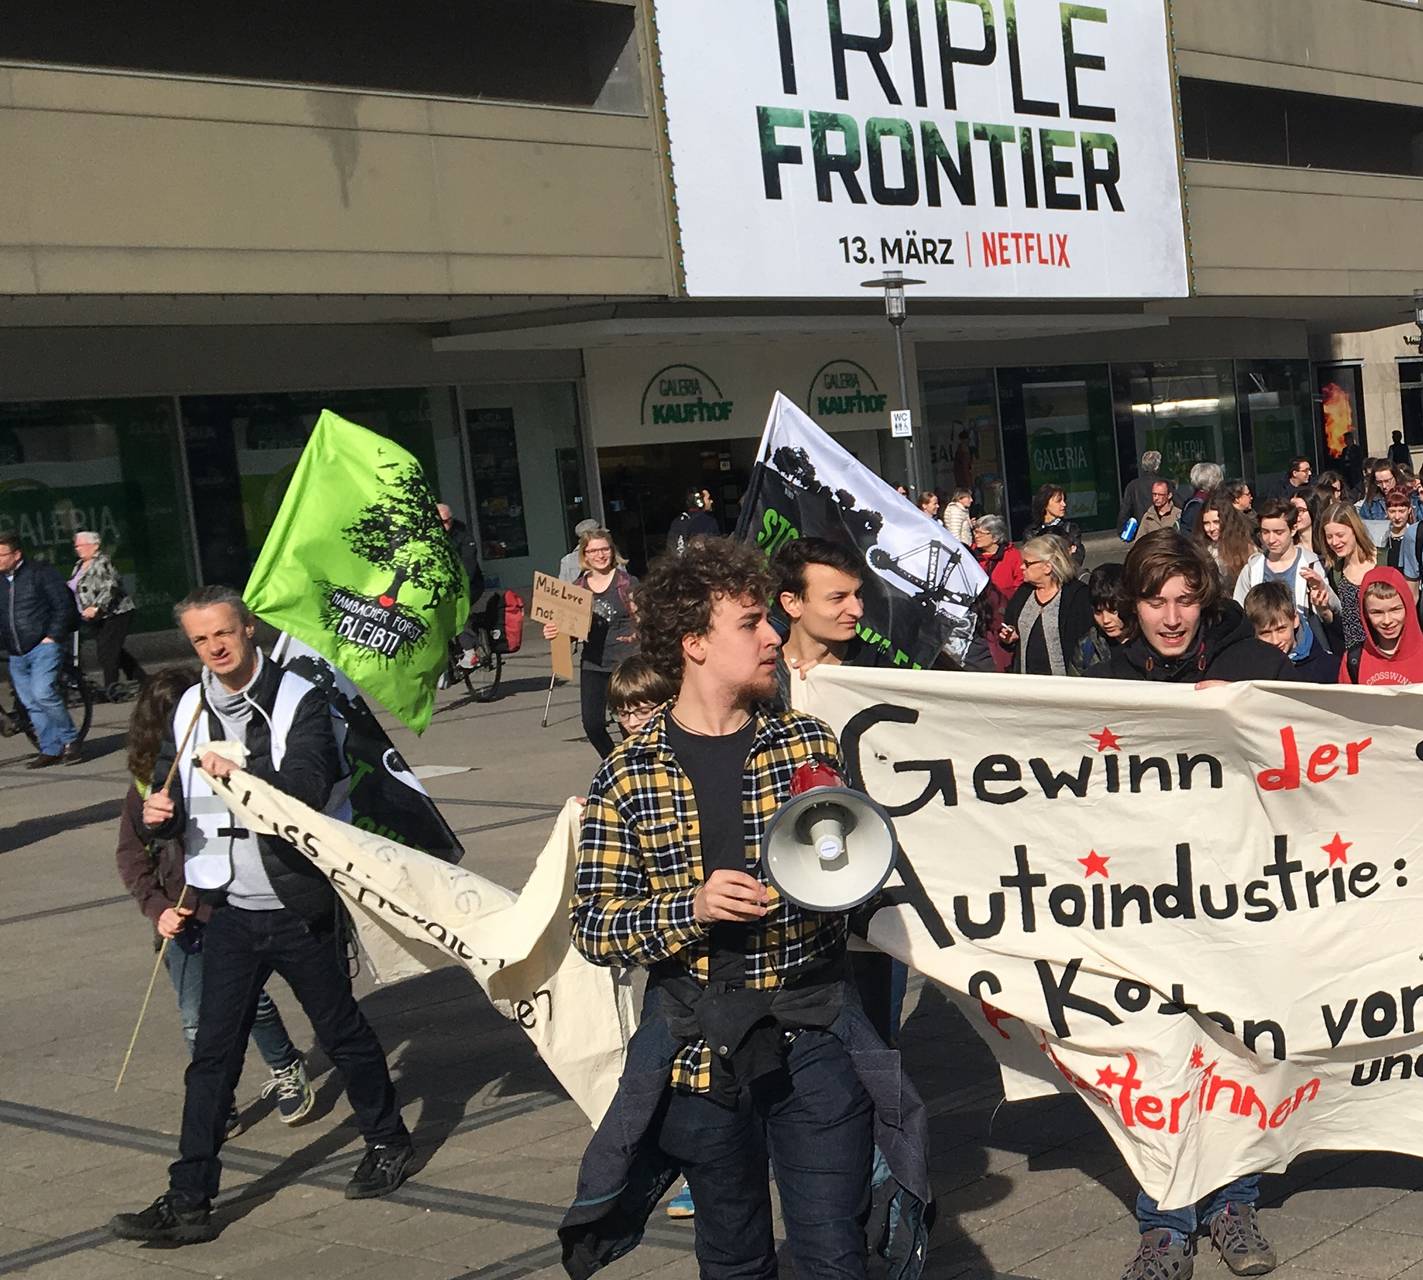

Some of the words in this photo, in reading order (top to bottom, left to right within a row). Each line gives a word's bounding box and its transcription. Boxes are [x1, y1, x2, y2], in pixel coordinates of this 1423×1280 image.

[756, 105, 1125, 212] FRONTIER
[838, 235, 875, 264] 13.
[880, 230, 955, 264] MÄRZ
[981, 231, 1071, 268] NETFLIX
[659, 379, 703, 397] GALERIA
[824, 372, 860, 390] GALERIA
[893, 412, 908, 422] WC
[1033, 445, 1088, 472] GALERIA
[535, 575, 560, 597] Make
[561, 586, 584, 605] Love
[331, 591, 390, 624] HAMBACHER
[391, 615, 421, 641] FORST
[535, 607, 554, 621] not
[337, 615, 400, 655] BLEIBT!
[1366, 671, 1412, 686] CROSSWIN
[840, 703, 1223, 818] Gewinn
[1256, 724, 1373, 792] der
